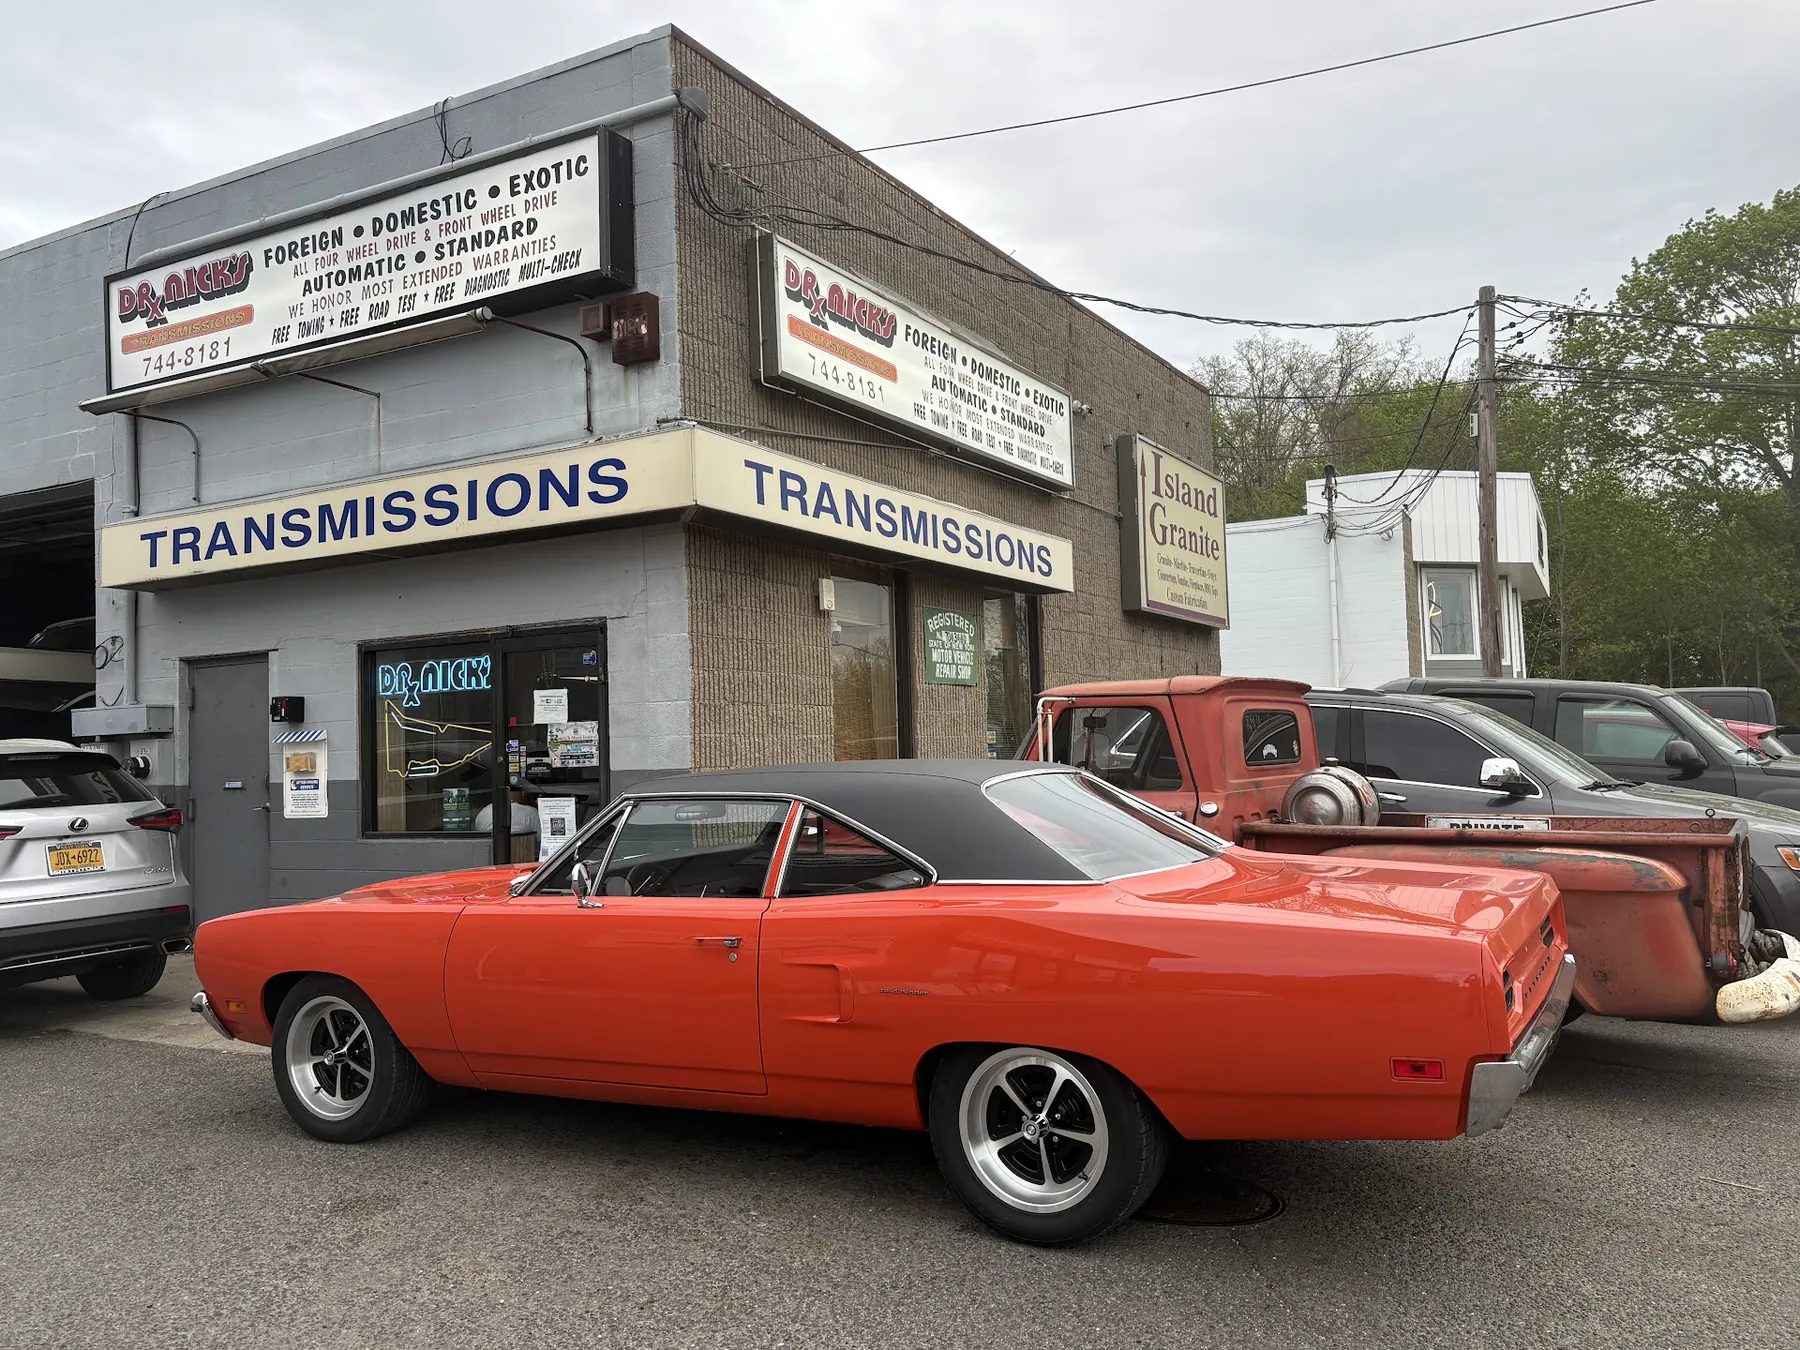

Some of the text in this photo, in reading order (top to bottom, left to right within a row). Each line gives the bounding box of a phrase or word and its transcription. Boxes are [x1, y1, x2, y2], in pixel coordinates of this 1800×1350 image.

[264, 155, 589, 268] FOREIGN DOMESTIC EXOTIC
[293, 191, 558, 279] ALL FOUR WHEEL DRIVE & FRONT WHEEL DRIVE
[164, 250, 253, 309] NICK'S
[288, 235, 556, 319] WE HONOR MOST EXTENDED WARRANTIES
[302, 218, 538, 297] AUTOMATIC STANDARD
[272, 249, 583, 345] FREE TOWING FREE ROAD TEST FREE DIAGNOSTIC MULTI-CHECK
[827, 282, 897, 348] NICK'S
[131, 312, 246, 347] TRANSMISSIONS
[143, 336, 231, 377] 744-8181
[795, 323, 892, 378] TRANSMISSIONS
[808, 353, 885, 403] 744-8181
[905, 324, 1065, 417] FOREIGN DOMESTIC EXOTIC
[924, 356, 935, 370] ALL
[939, 362, 955, 379] FOUR
[958, 372, 975, 390] WHEEL
[977, 382, 992, 398] DRIVE
[1002, 393, 1018, 410] FRONT
[1021, 403, 1037, 419] WHEEL
[1039, 411, 1053, 426] DRIVE
[914, 402, 926, 420] FREE
[930, 410, 948, 430] TOWING
[957, 420, 967, 437] FREE
[986, 433, 996, 449] TEST
[1003, 440, 1014, 456] FREE
[922, 389, 1054, 455] WE HONOR MOST EXTENDED WARRANTIES
[932, 375, 1045, 438] AUTOMATIC STANDARD
[140, 458, 629, 569] TRANSMISSIONS
[1151, 451, 1218, 518] Island
[744, 459, 1053, 578] TRANSMISSIONS
[1149, 502, 1220, 561] Granite
[927, 612, 974, 637] REGISTERED
[929, 640, 942, 648] STATE
[932, 648, 974, 665] MOTOR VEHICLE
[936, 664, 971, 679] REPAIR SHOP
